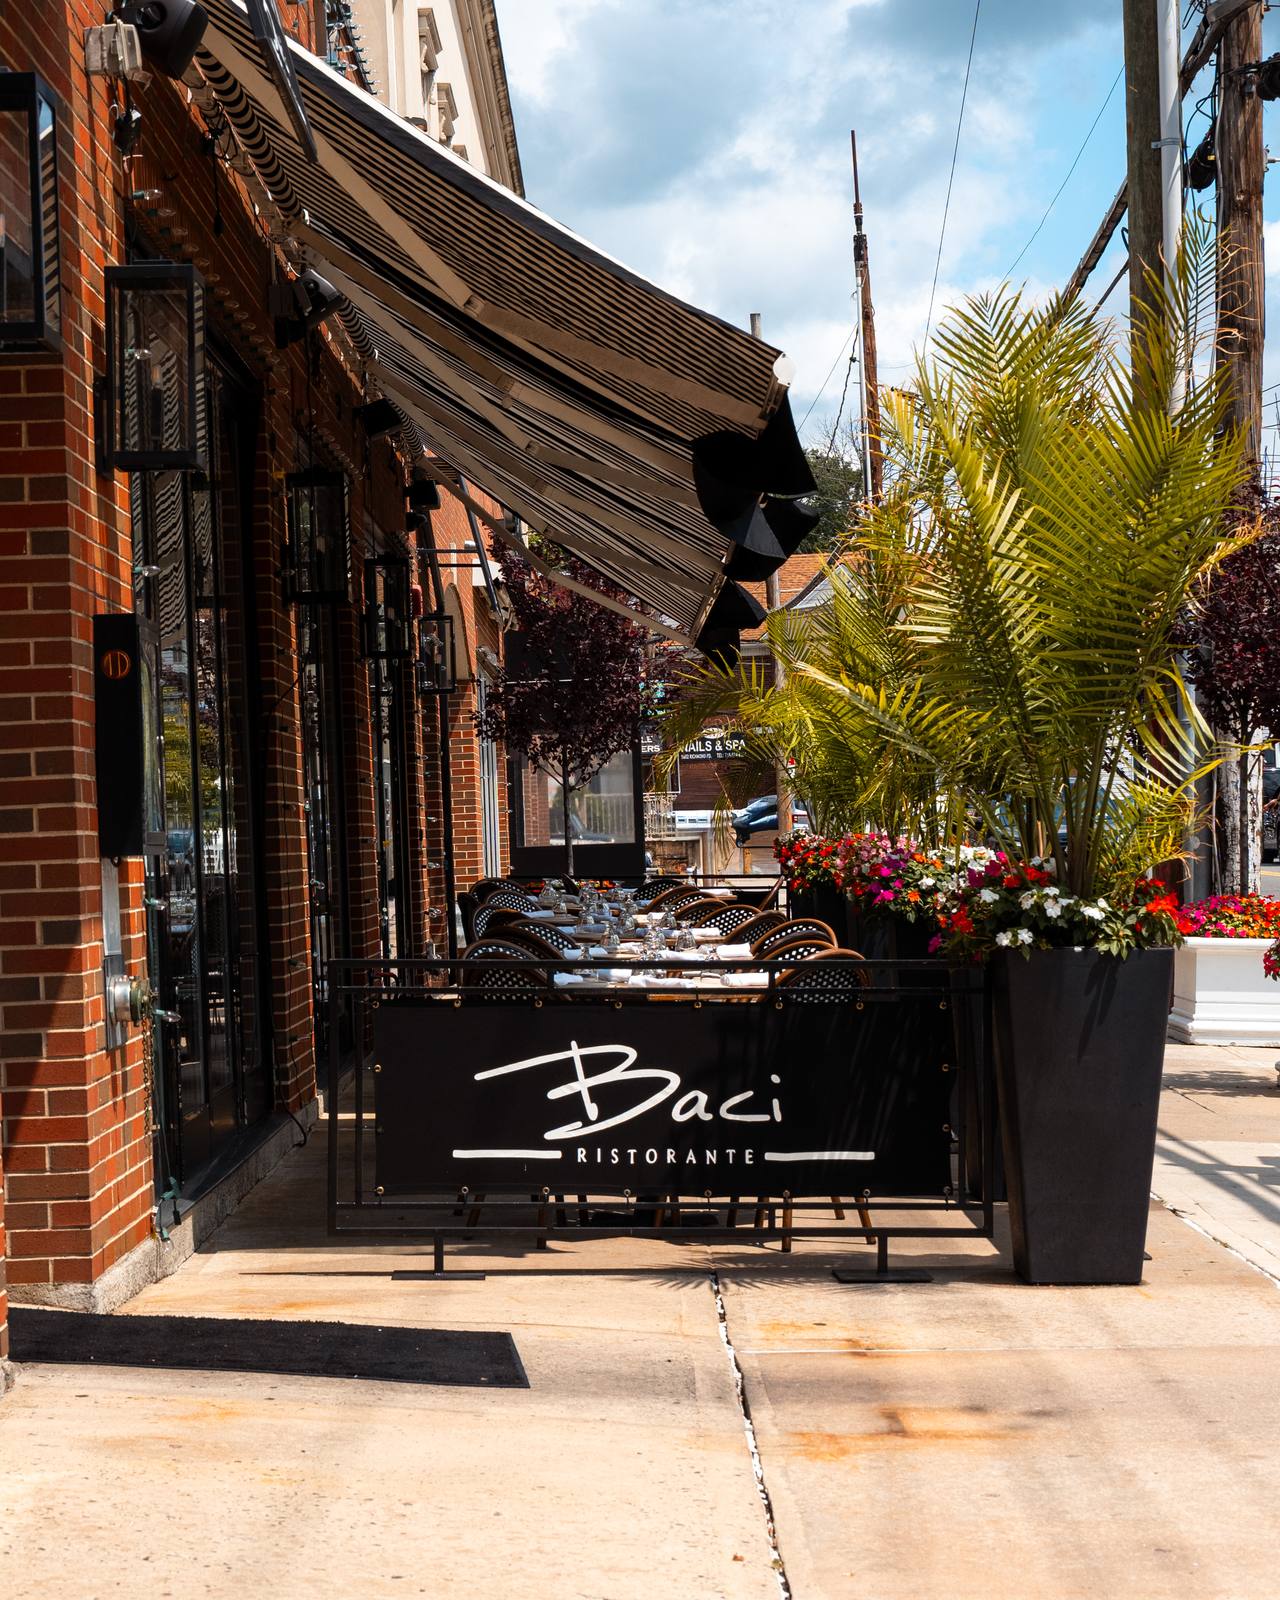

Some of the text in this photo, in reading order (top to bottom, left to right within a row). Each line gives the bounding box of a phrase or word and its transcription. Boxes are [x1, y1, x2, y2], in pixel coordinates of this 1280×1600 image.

[714, 740, 723, 751] &
[725, 739, 746, 751] SPA
[474, 1040, 783, 1140] Baci
[577, 1147, 754, 1165] RISTORANTE
